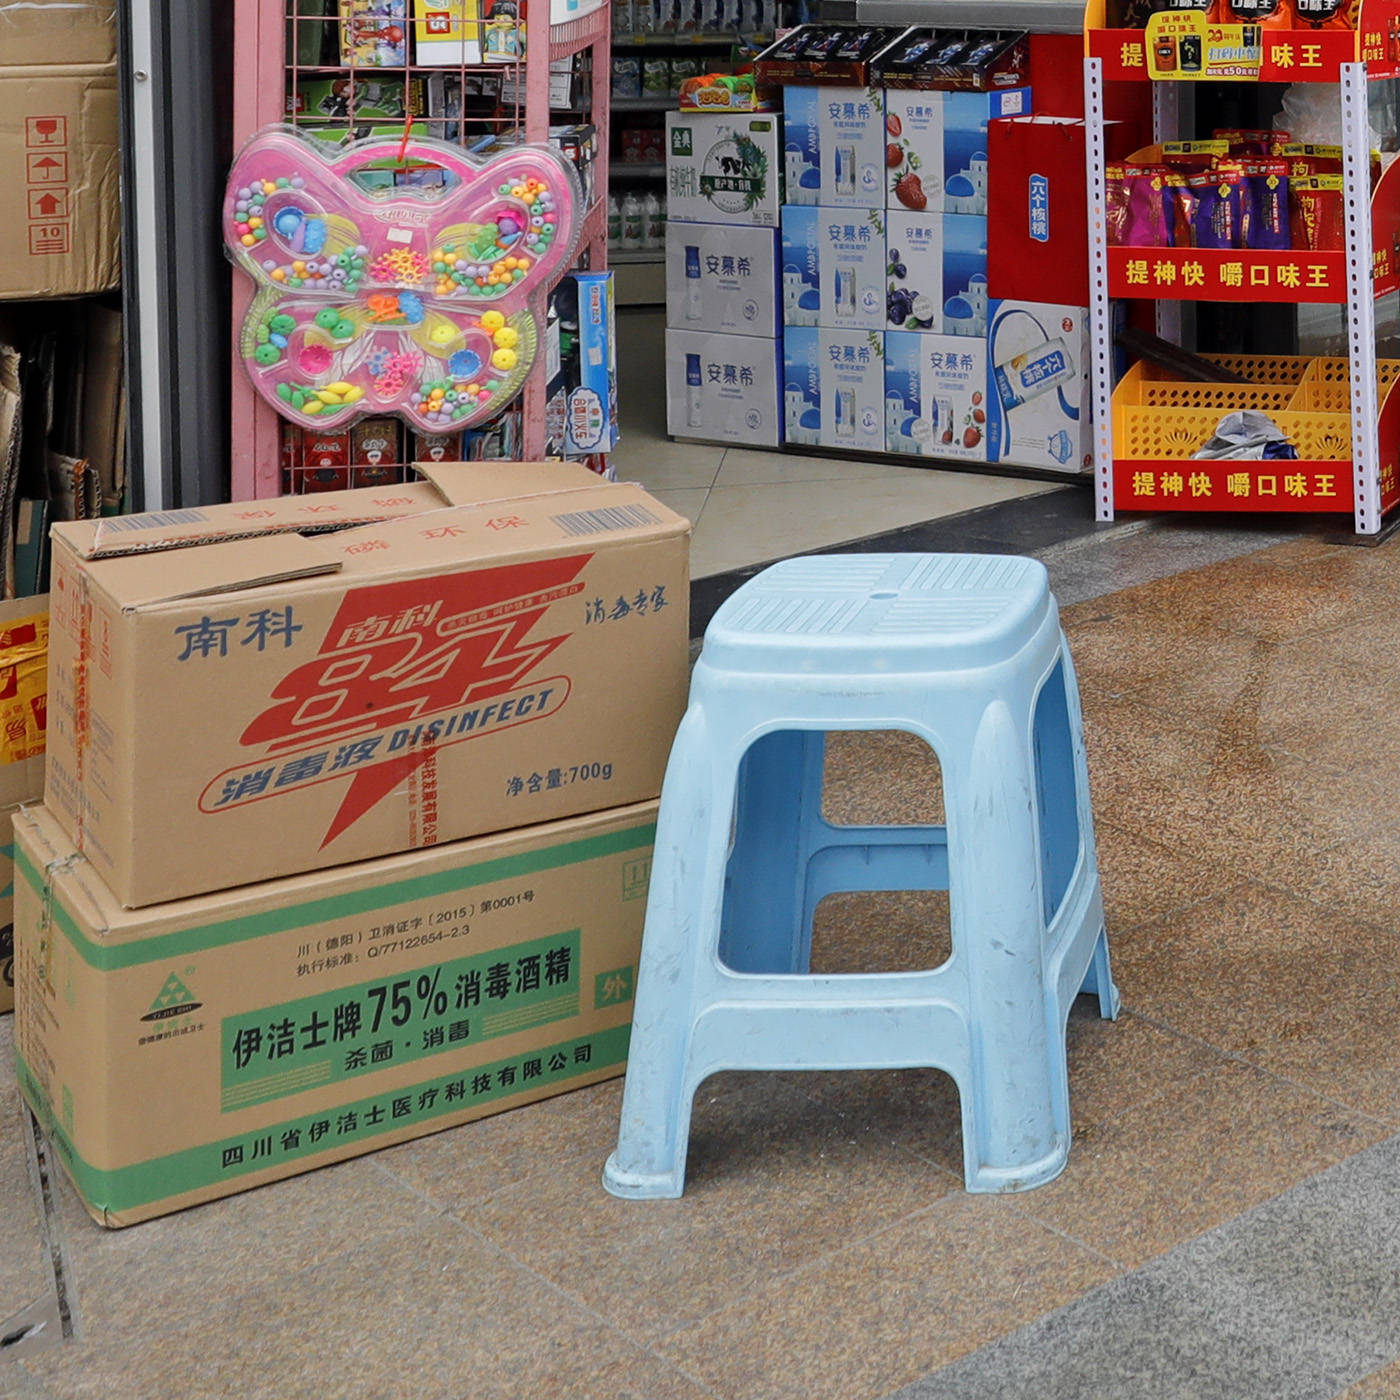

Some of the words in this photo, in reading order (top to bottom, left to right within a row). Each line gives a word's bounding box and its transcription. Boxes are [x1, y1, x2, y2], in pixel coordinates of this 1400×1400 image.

[1298, 0, 1337, 11] 口味王
[828, 102, 871, 120] 安慕希
[905, 105, 933, 118] 安慕希
[671, 130, 692, 149] 金典
[1031, 180, 1047, 236] 六个核桃
[38, 227, 61, 238] 10
[828, 224, 872, 242] 安慕希
[905, 227, 933, 239] 安慕希
[705, 255, 751, 277] 安慕希
[1126, 260, 1205, 286] 提神快
[1219, 262, 1330, 288] 嚼口味王
[828, 344, 872, 363] 安慕希
[930, 352, 974, 370] 安慕希
[707, 363, 754, 386] 安慕希
[1132, 471, 1213, 497] 提神快
[1226, 472, 1337, 498] 嚼口味王
[585, 585, 669, 626] 消毒专家
[174, 605, 303, 662] 南科
[337, 600, 444, 648] 南科
[238, 618, 560, 750] 84
[213, 733, 385, 808] 消毒液
[387, 688, 554, 752] DISINFECT
[506, 761, 613, 797] 净含量:700g
[600, 974, 628, 1003] 外
[232, 946, 572, 1069] 伊洁士牌75%消毒酒精
[344, 1018, 471, 1071] 杀菌·消毒
[221, 1043, 593, 1169] 四川省伊洁士医疗科技有限公司
